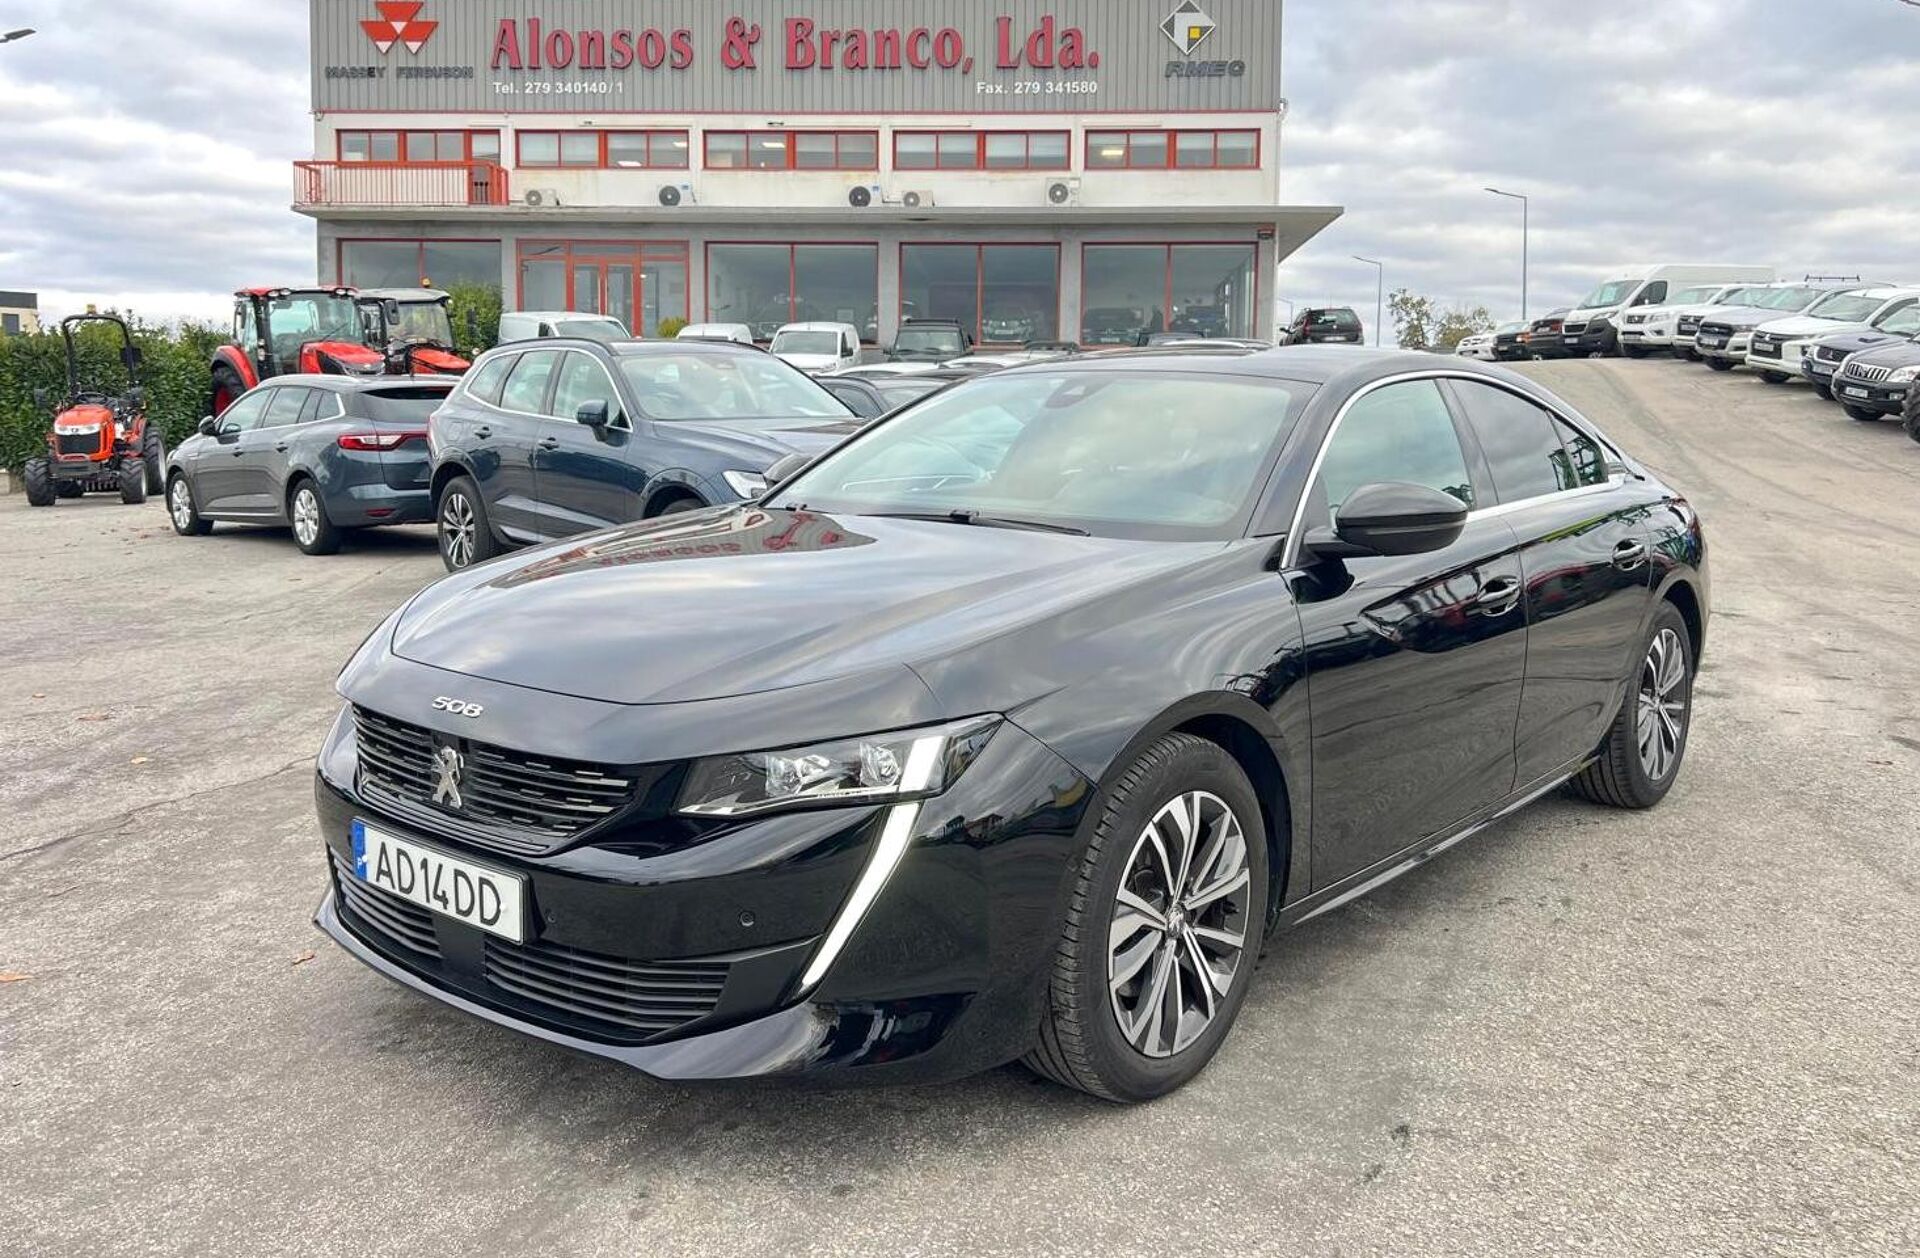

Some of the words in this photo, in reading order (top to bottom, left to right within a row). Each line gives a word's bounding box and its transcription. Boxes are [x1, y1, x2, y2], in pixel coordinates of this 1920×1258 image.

[491, 17, 694, 69] Alonsos
[721, 17, 761, 69] &
[785, 17, 973, 74] Branco,
[996, 15, 1099, 70] Lda.
[325, 66, 386, 79] MASSEY
[396, 66, 474, 79] FERGUSON
[493, 82, 519, 94] Tel.
[525, 82, 550, 94] 279
[976, 81, 1009, 94] Fax.
[1013, 81, 1040, 94] 279
[1045, 81, 1098, 94] 341580
[431, 696, 484, 718] 508
